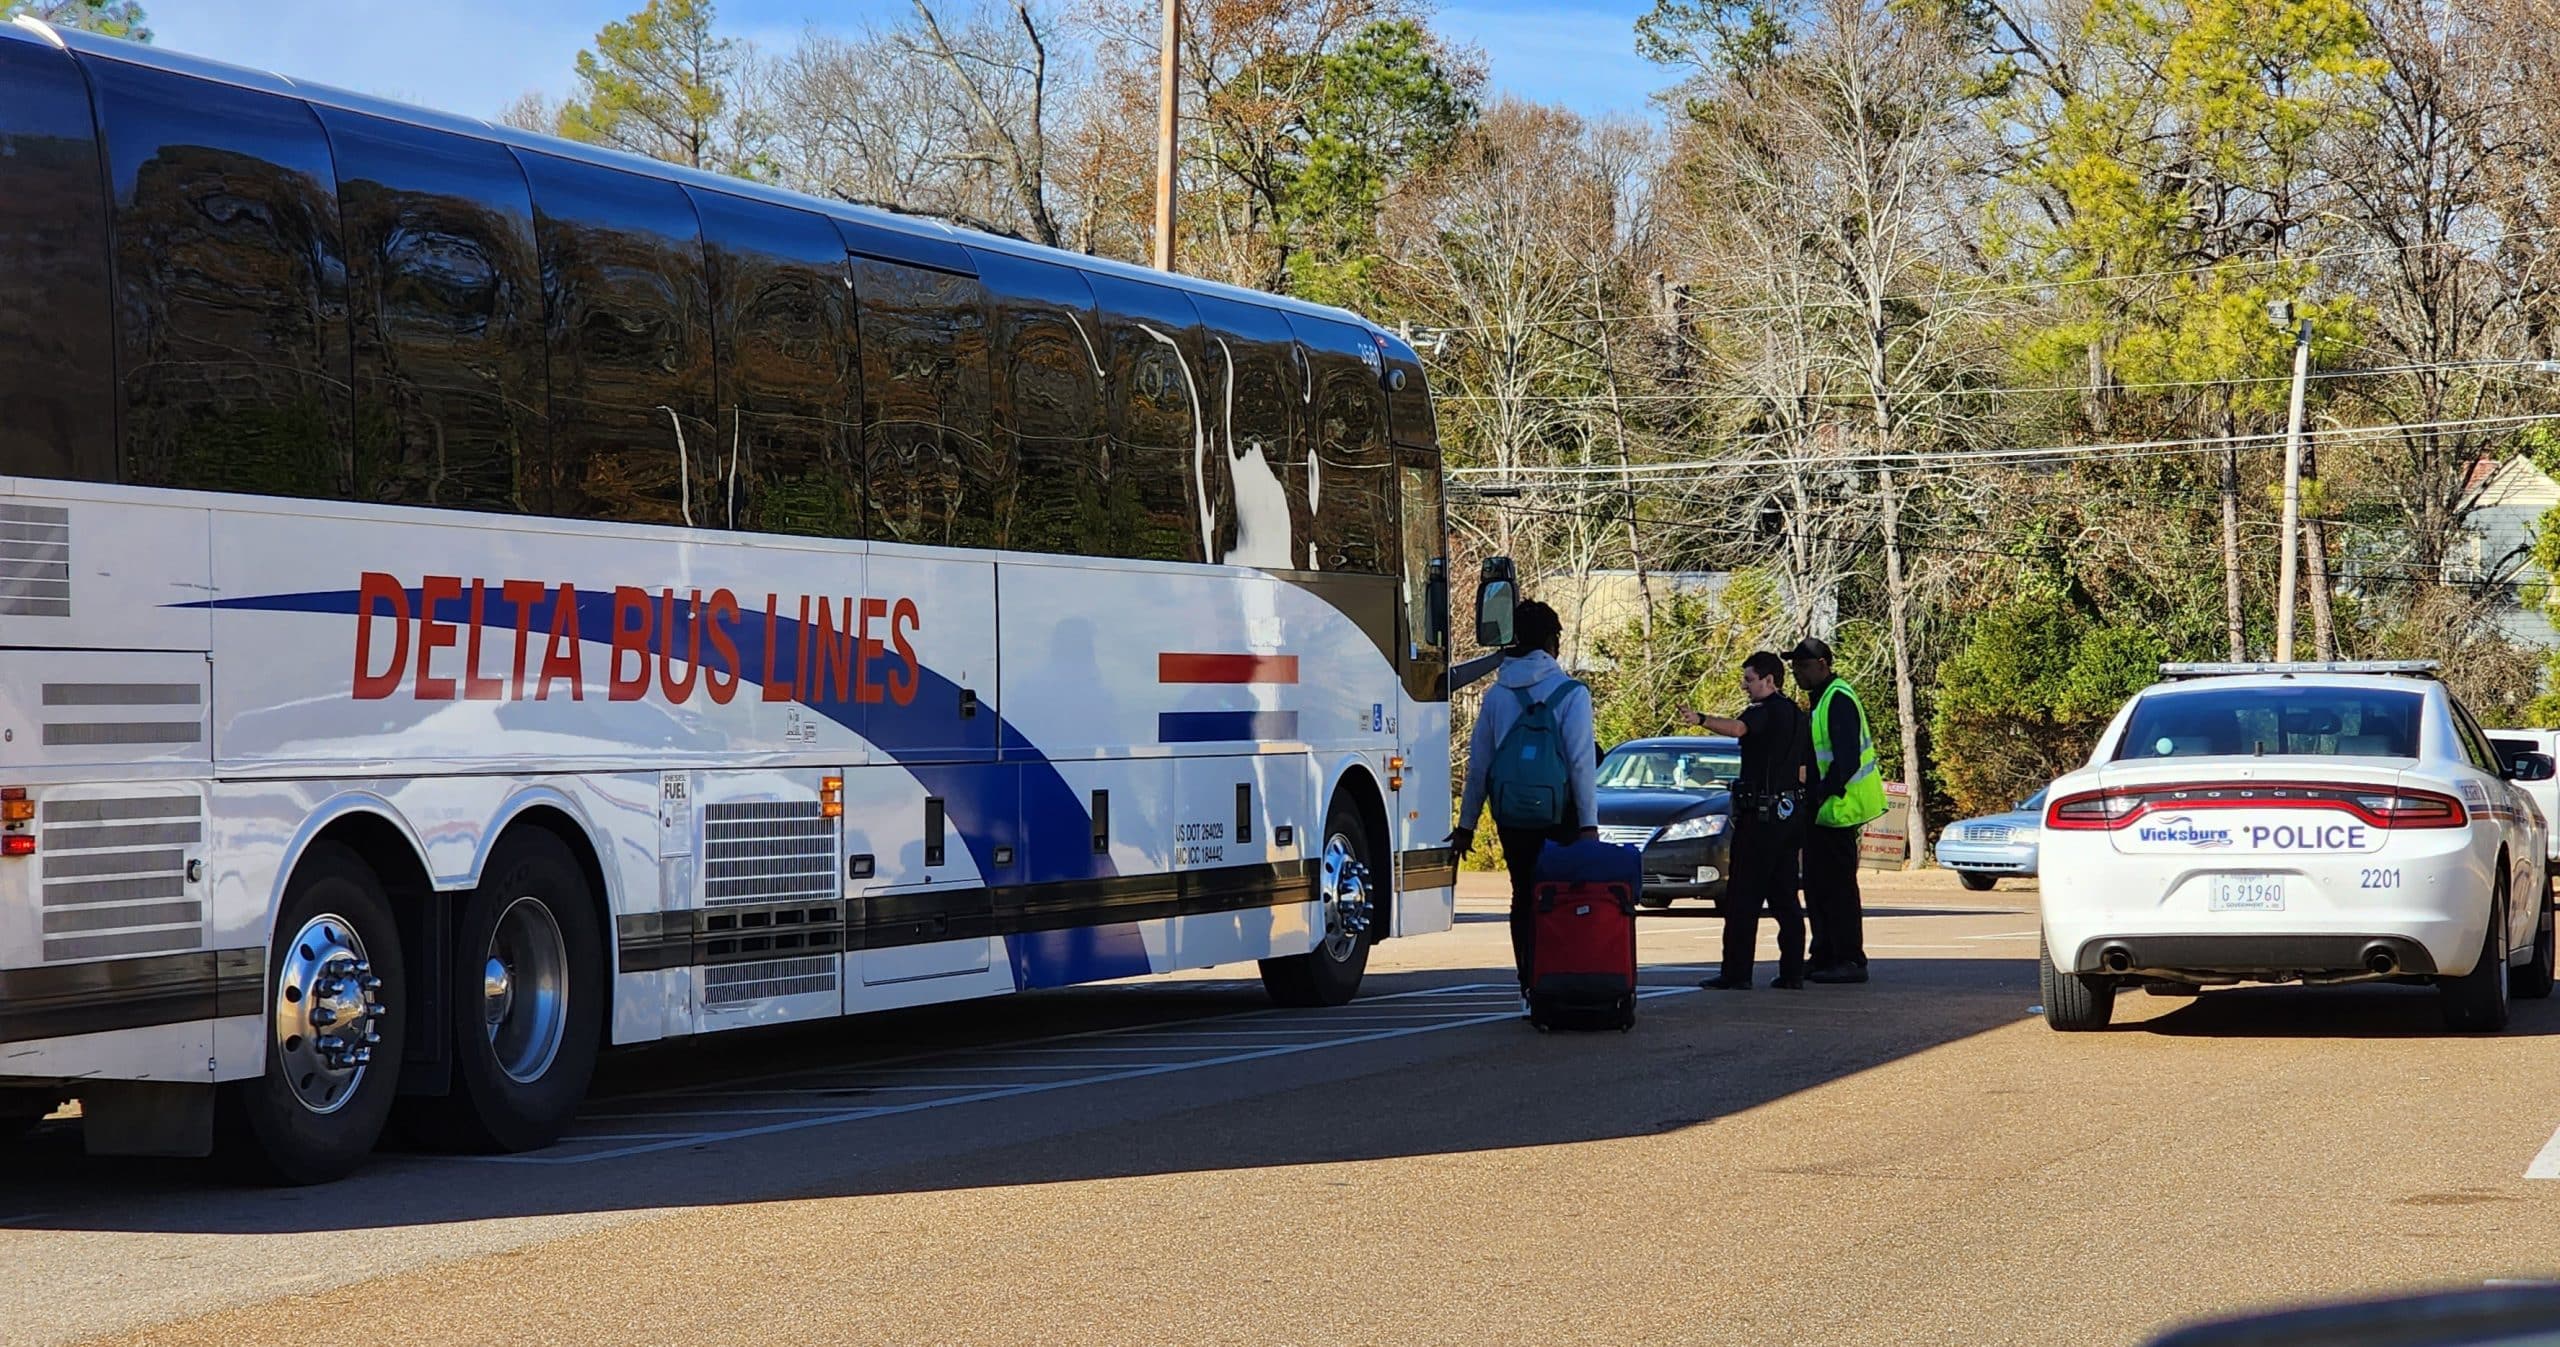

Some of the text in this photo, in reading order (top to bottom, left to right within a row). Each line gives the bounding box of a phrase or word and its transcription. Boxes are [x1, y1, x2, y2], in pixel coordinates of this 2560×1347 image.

[352, 571, 920, 706] DELTA BUS LINES
[664, 774, 686, 782] DIESEL
[664, 782, 686, 799] FUEL
[1175, 823, 1185, 842] US
[1186, 823, 1200, 841] DOT
[2139, 826, 2366, 849] Vicksburg POLICE
[1175, 846, 1187, 865] MC
[1187, 846, 1200, 864] ICC
[2360, 868, 2401, 889] 2201
[2222, 884, 2281, 902] G 91960
